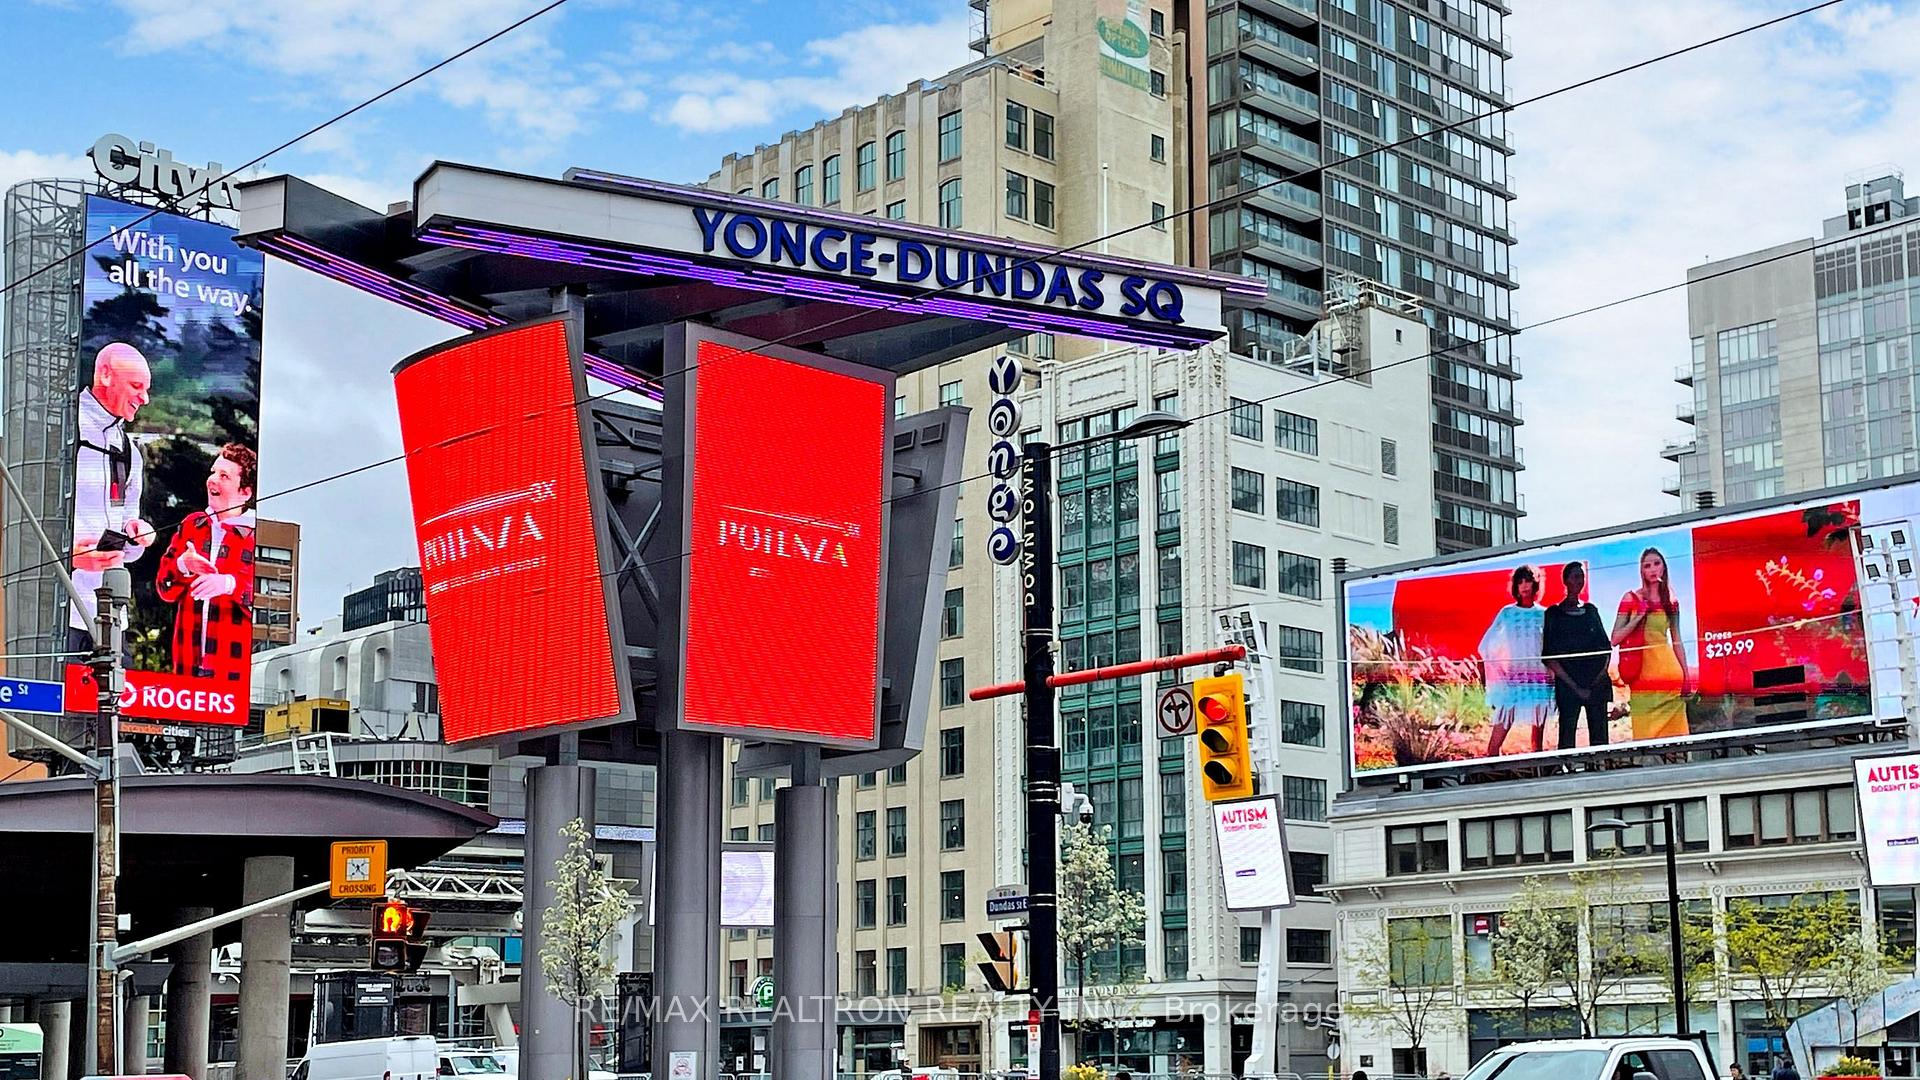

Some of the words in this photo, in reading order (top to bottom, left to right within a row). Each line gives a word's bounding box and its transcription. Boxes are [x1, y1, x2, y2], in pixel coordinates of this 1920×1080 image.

[110, 225, 174, 263] With
[180, 248, 228, 275] you
[692, 206, 1105, 310] YONGE-DUNDAS
[1120, 275, 1184, 324] SQ
[109, 259, 140, 288] all
[147, 267, 190, 298] the
[197, 281, 252, 316] way.
[1024, 458, 1035, 607] DOWNTOWN
[1705, 631, 1733, 642] Dress
[1705, 639, 1755, 659] $29.99
[18, 684, 29, 695] St
[143, 688, 236, 714] ROGERS
[1868, 763, 1920, 783] AUTIS
[1222, 807, 1268, 825] AUTISM
[341, 845, 376, 855] PRIORITY
[339, 884, 377, 894] CROSSING
[990, 901, 1016, 912] Dundas
[1023, 898, 1028, 909] E
